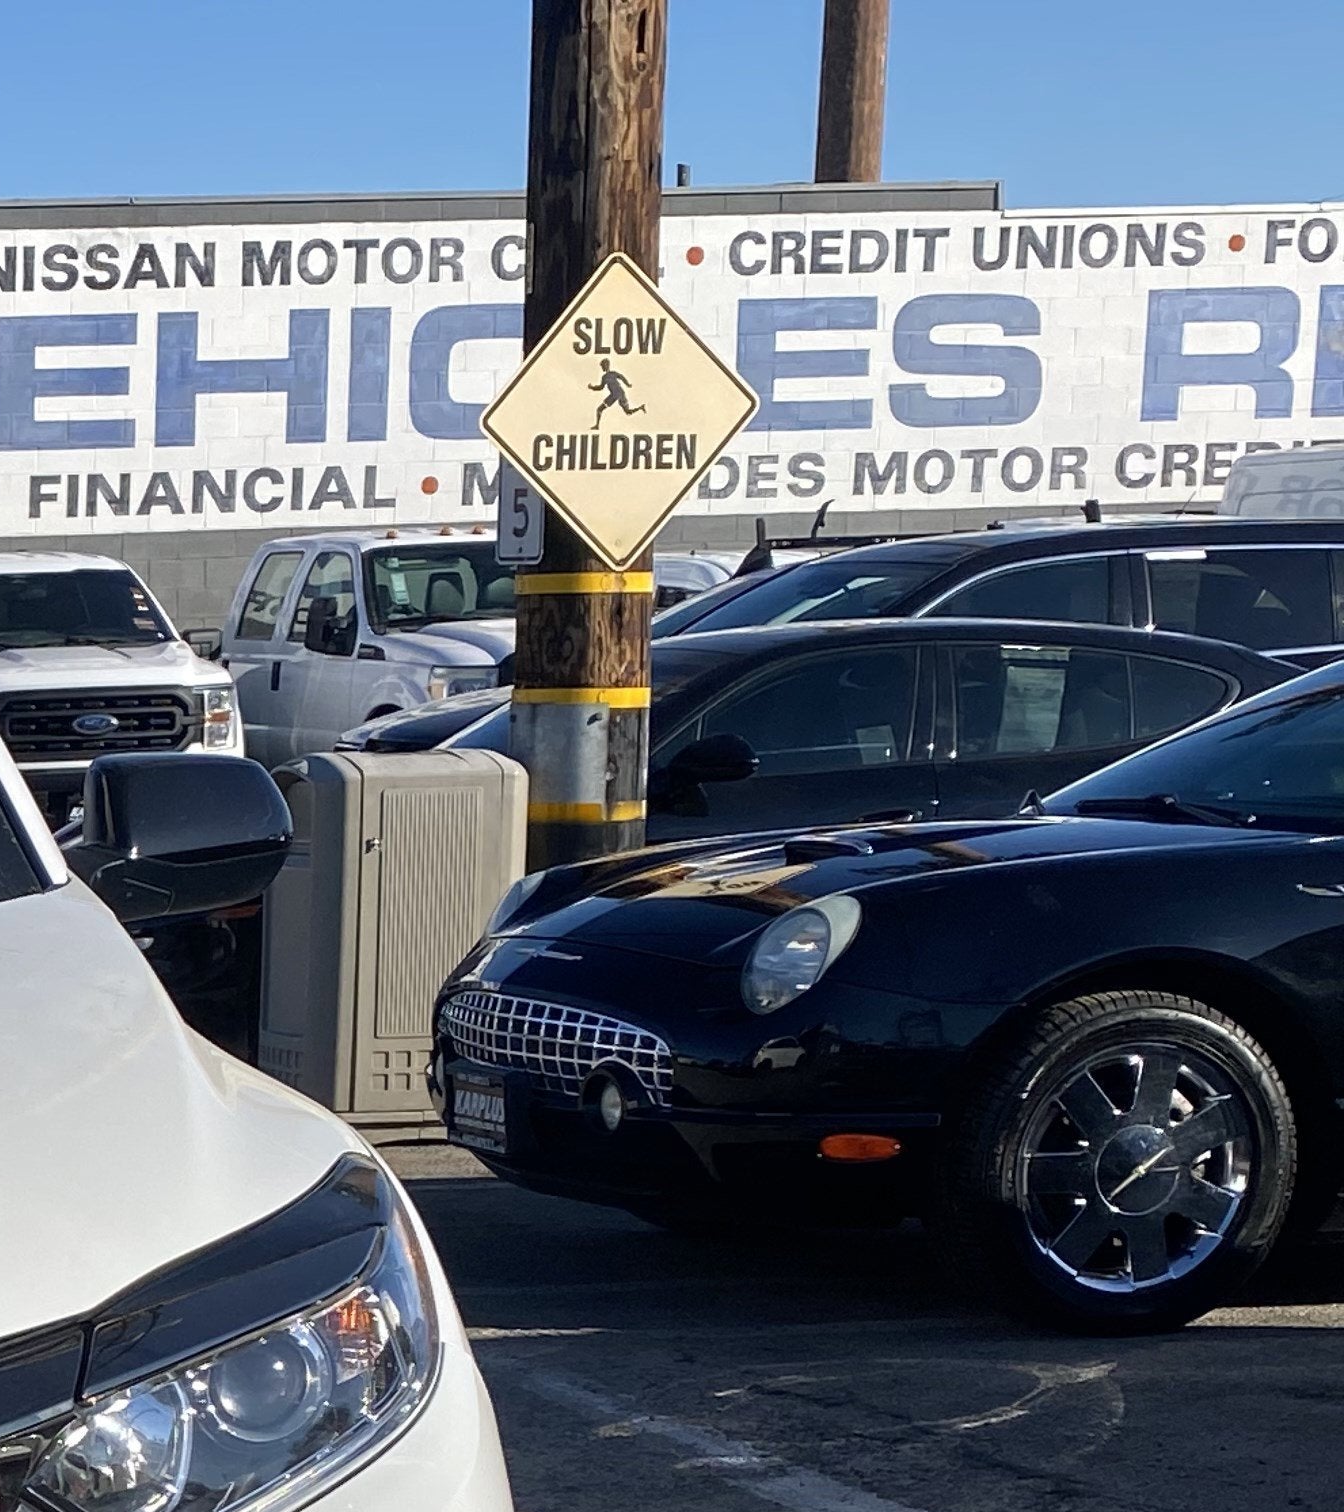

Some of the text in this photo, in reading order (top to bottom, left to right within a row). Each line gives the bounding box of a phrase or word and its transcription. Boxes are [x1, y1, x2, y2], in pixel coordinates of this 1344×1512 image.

[241, 236, 465, 287] MOTOR
[728, 228, 951, 275] CREDIT
[972, 222, 1207, 272] UNIONS
[1264, 217, 1344, 264] FO
[572, 316, 668, 356] SLOW
[1139, 285, 1344, 423] R
[28, 464, 398, 520] FINANCIAL
[461, 451, 826, 507] MDES
[851, 446, 1090, 497] MOTOR
[1114, 438, 1344, 490] CRE
[531, 432, 698, 473] CHILDREN
[512, 487, 530, 539] 5
